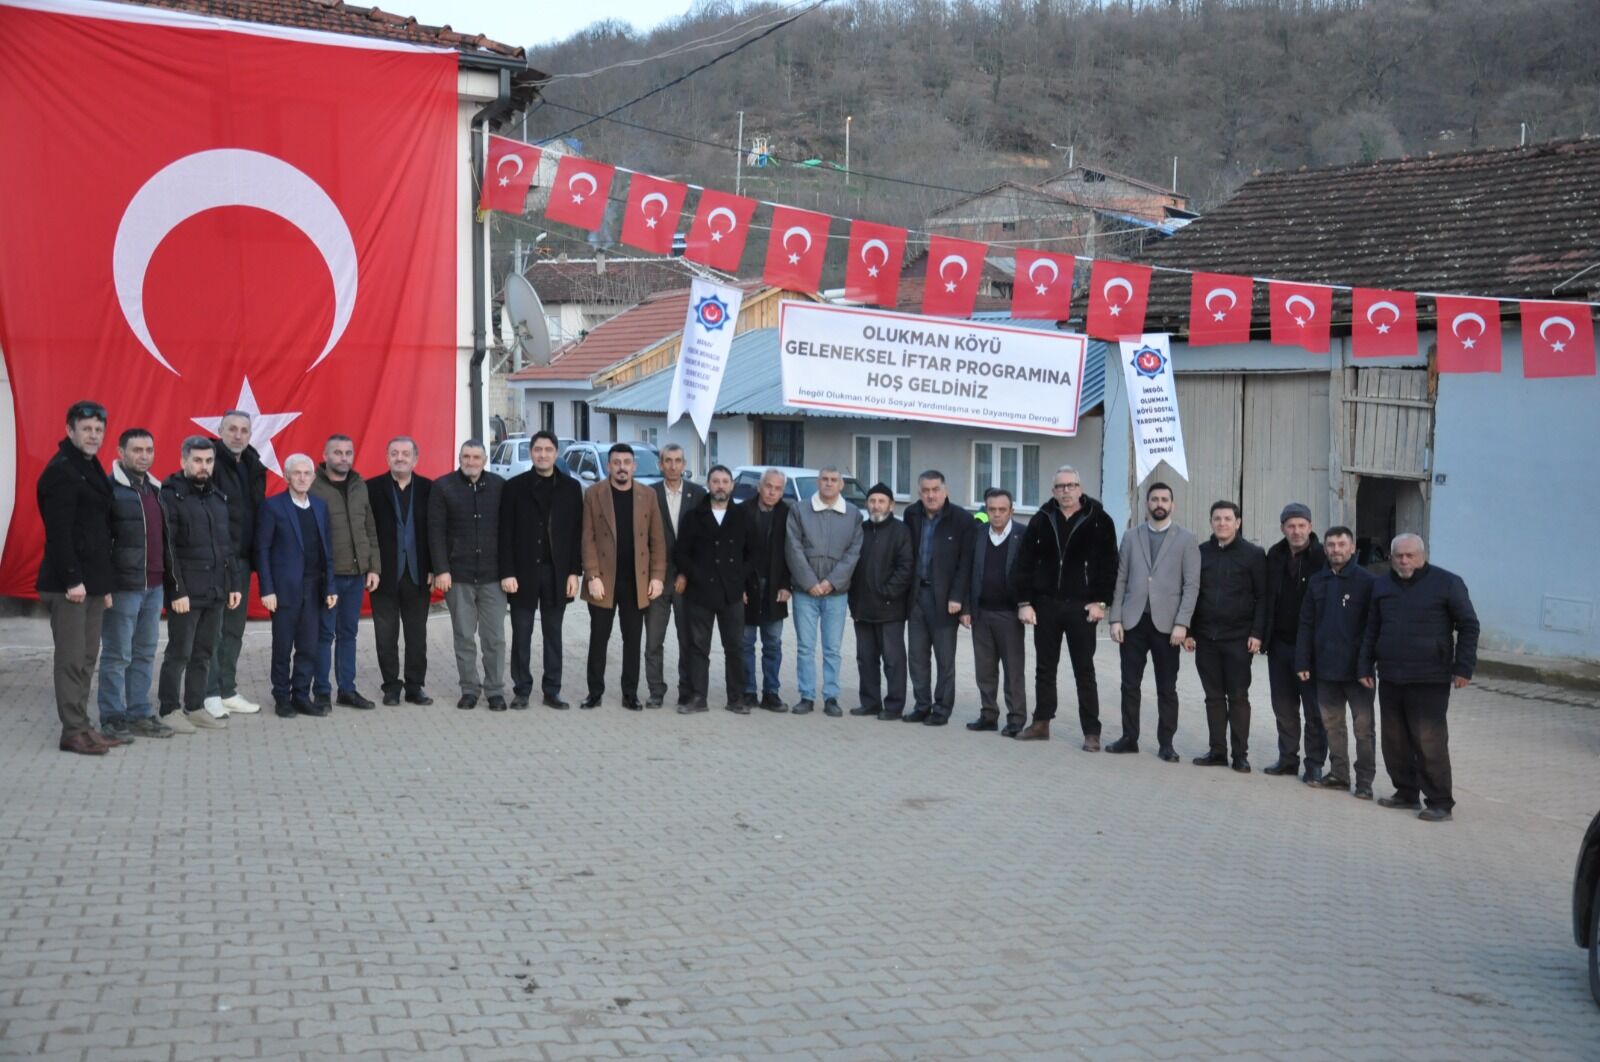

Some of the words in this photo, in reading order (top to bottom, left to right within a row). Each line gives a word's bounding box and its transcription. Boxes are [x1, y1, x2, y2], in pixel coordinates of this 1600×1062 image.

[863, 325, 949, 349] OLUKMAN
[954, 334, 1001, 354] KÖYÜ
[785, 340, 896, 366] GELENEKSEL
[902, 350, 951, 372] İFTAR
[956, 359, 1071, 386] PROGRAMINA
[867, 372, 903, 392] HOŞ
[908, 377, 988, 399] GELDİNİZ
[1142, 385, 1164, 394] İNEGÖL
[1140, 396, 1169, 404] OLUKMAN
[798, 387, 824, 398] İnegöl
[826, 390, 862, 401] Olukman
[864, 395, 886, 405] Köyü
[888, 398, 915, 408] Sosyal
[917, 401, 969, 415] Yardımlaşma
[982, 407, 1027, 420] Dayanışma
[1028, 412, 1060, 424] Derneği
[1136, 406, 1153, 415] KÖYÜ
[1136, 415, 1176, 424] YARDIMLAŞMA
[1143, 436, 1176, 445] DAYANIŞMA
[1149, 445, 1174, 454] DERNEĞİ
